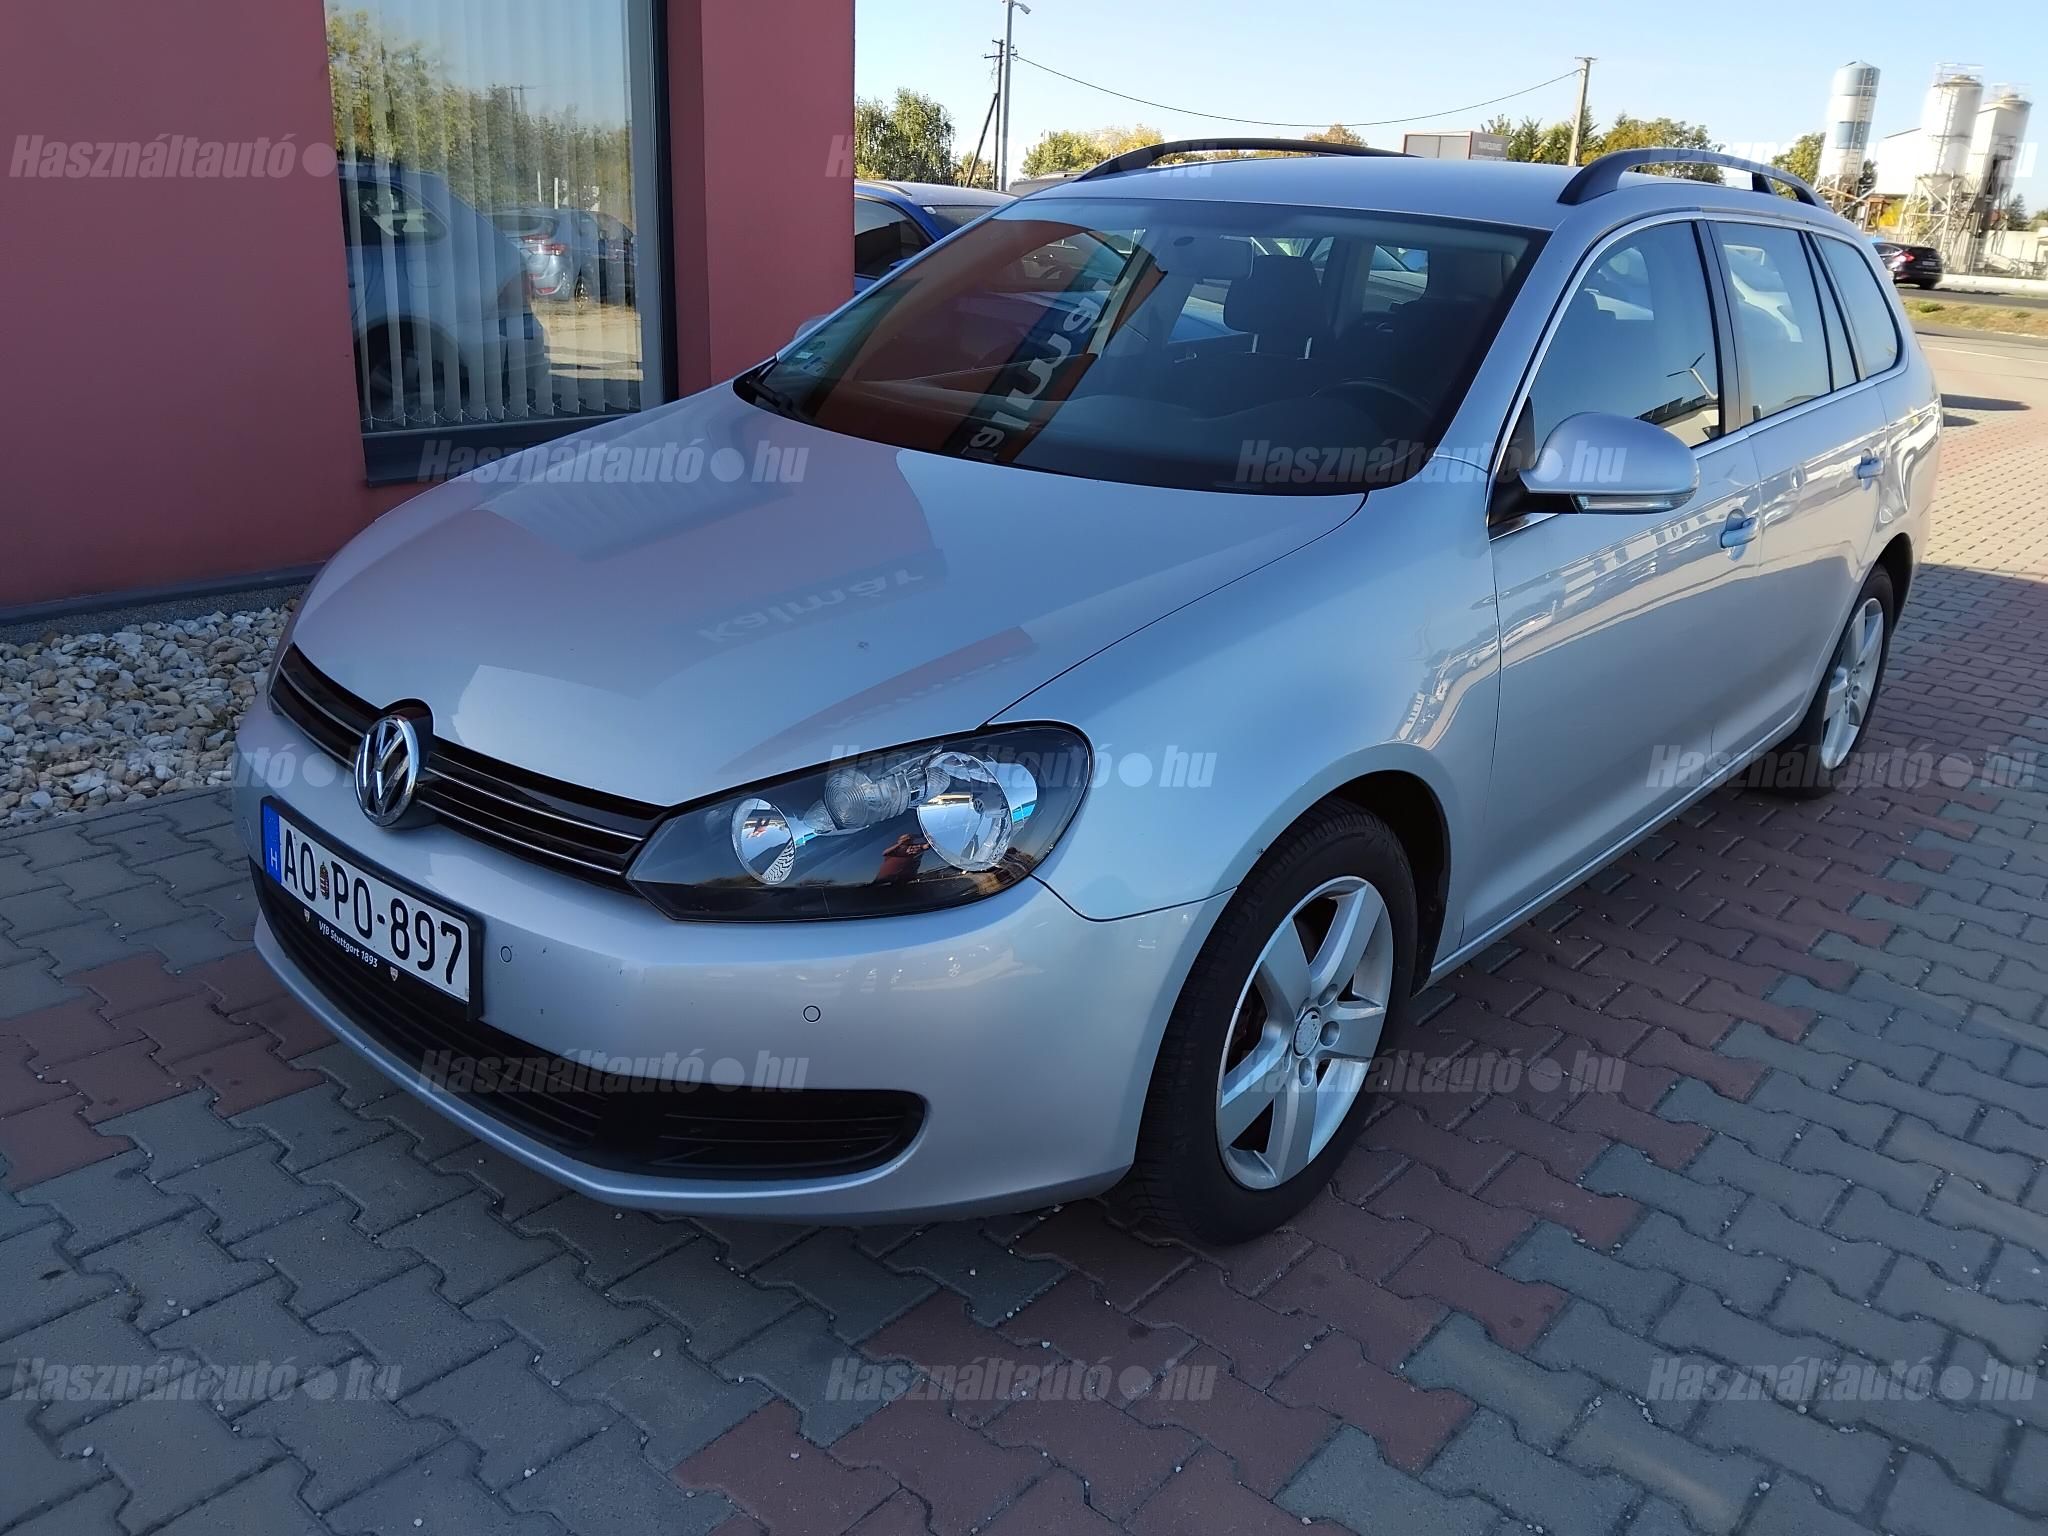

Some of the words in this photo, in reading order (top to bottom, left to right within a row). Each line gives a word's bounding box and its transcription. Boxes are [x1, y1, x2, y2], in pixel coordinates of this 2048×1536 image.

[270, 848, 278, 871] H
[331, 861, 462, 985] PO-897
[319, 920, 329, 935] VfB
[330, 929, 360, 957] Stuttgart
[361, 950, 378, 968] 1893
